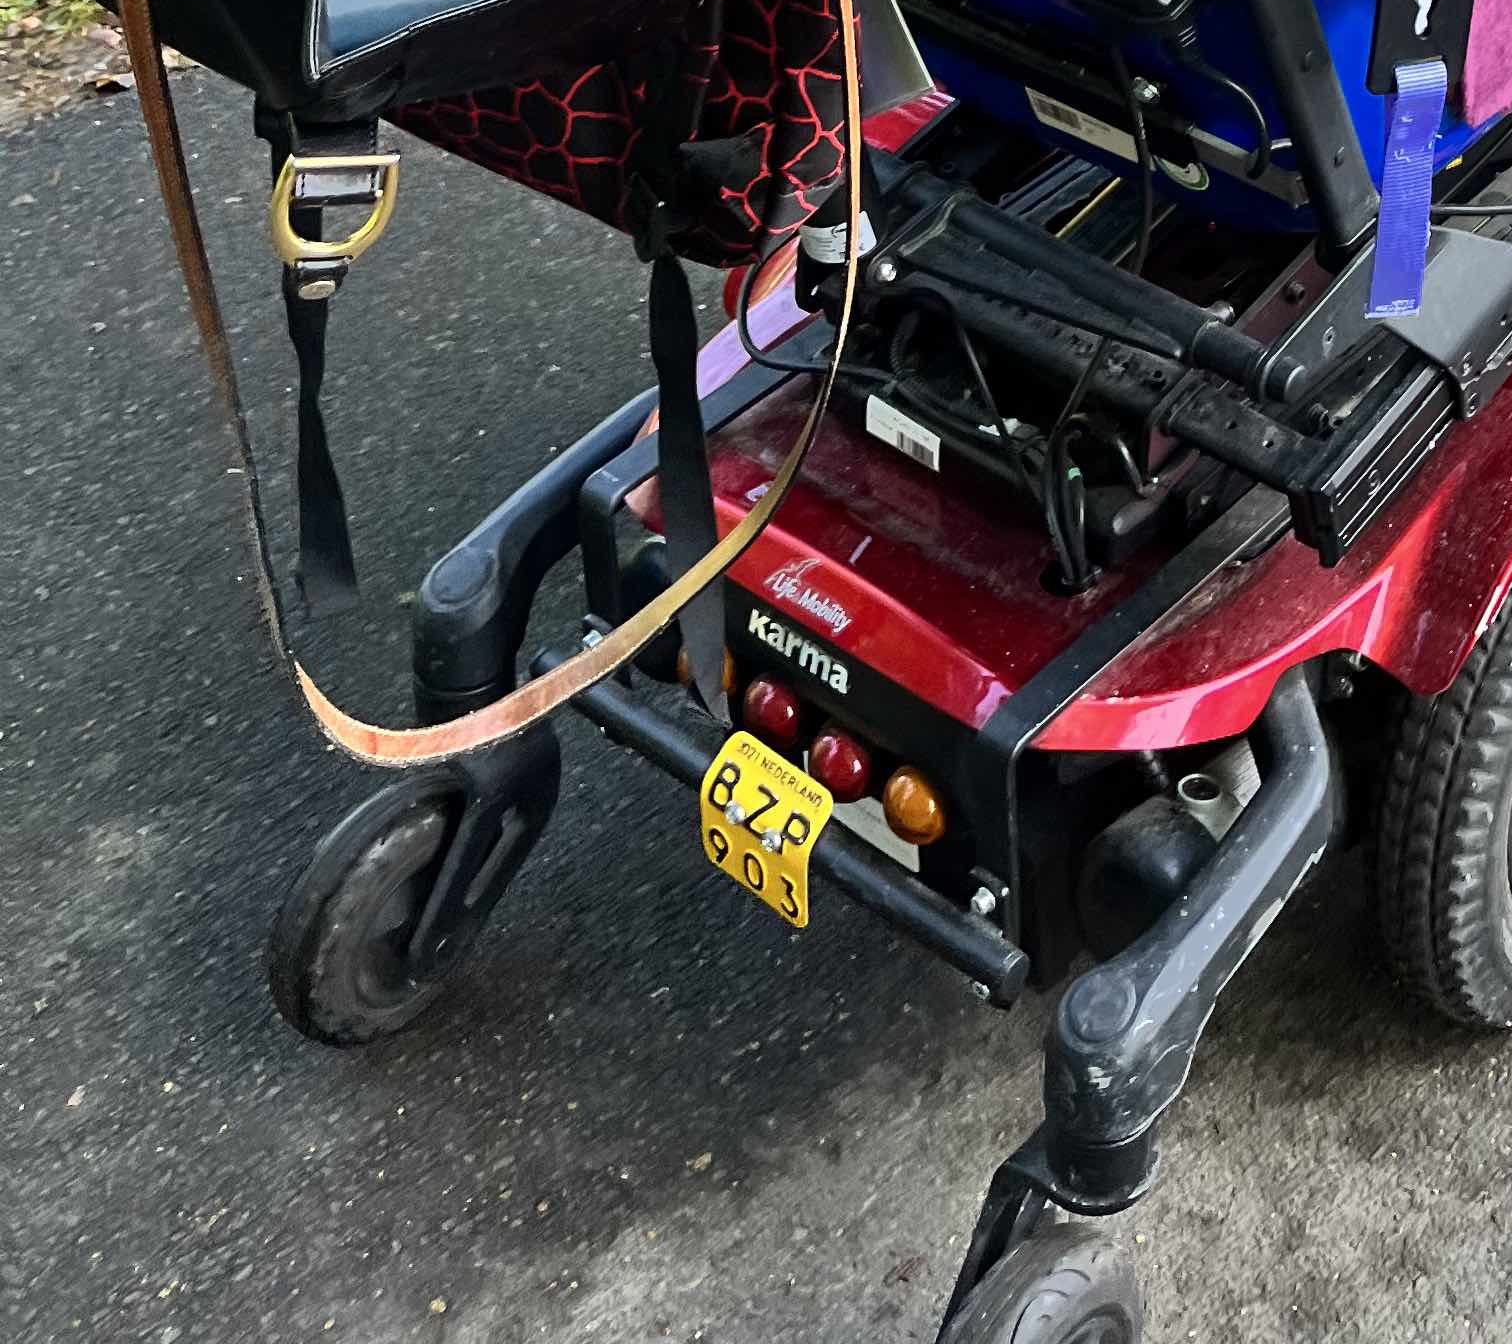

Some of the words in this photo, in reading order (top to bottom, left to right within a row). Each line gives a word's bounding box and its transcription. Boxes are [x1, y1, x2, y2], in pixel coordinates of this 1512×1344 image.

[772, 573, 799, 600] Life
[799, 588, 852, 633] Mobility
[708, 761, 811, 856] BZP
[761, 756, 823, 808] NEDERLAND
[708, 828, 800, 919] 903
